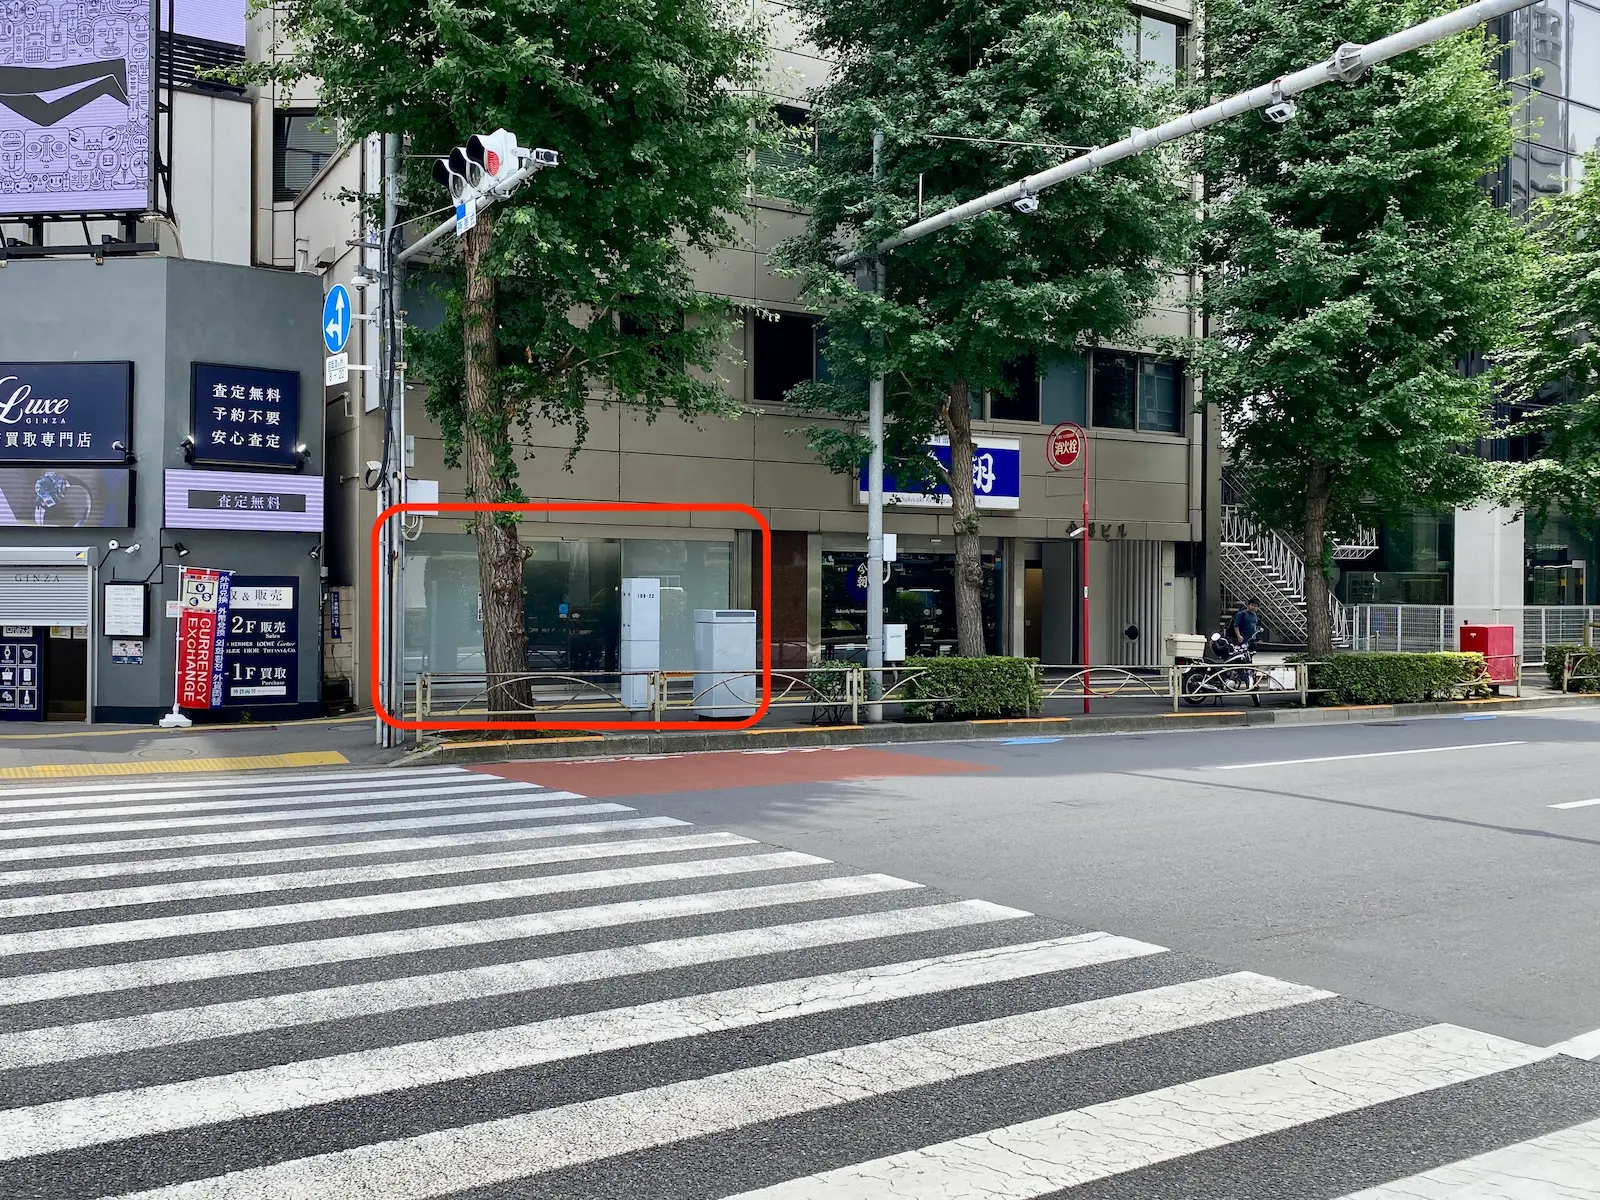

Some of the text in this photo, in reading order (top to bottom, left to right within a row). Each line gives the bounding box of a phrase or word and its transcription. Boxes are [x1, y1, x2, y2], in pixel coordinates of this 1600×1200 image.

[0, 376, 69, 424] Luxe
[212, 383, 281, 403] 査定無料
[212, 406, 281, 426] 予約不要
[0, 431, 92, 448] 買取専門店
[211, 430, 281, 449] 安心査定
[1054, 439, 1077, 456] 消火栓
[217, 494, 281, 510] 査定無料
[14, 573, 60, 583] GINZA
[242, 590, 250, 601] &
[255, 589, 282, 601] 販売
[231, 616, 286, 634] 2F 販売
[183, 617, 199, 702] EXCHANGE
[196, 617, 212, 703] CURRENCY
[260, 667, 287, 680] 買取
